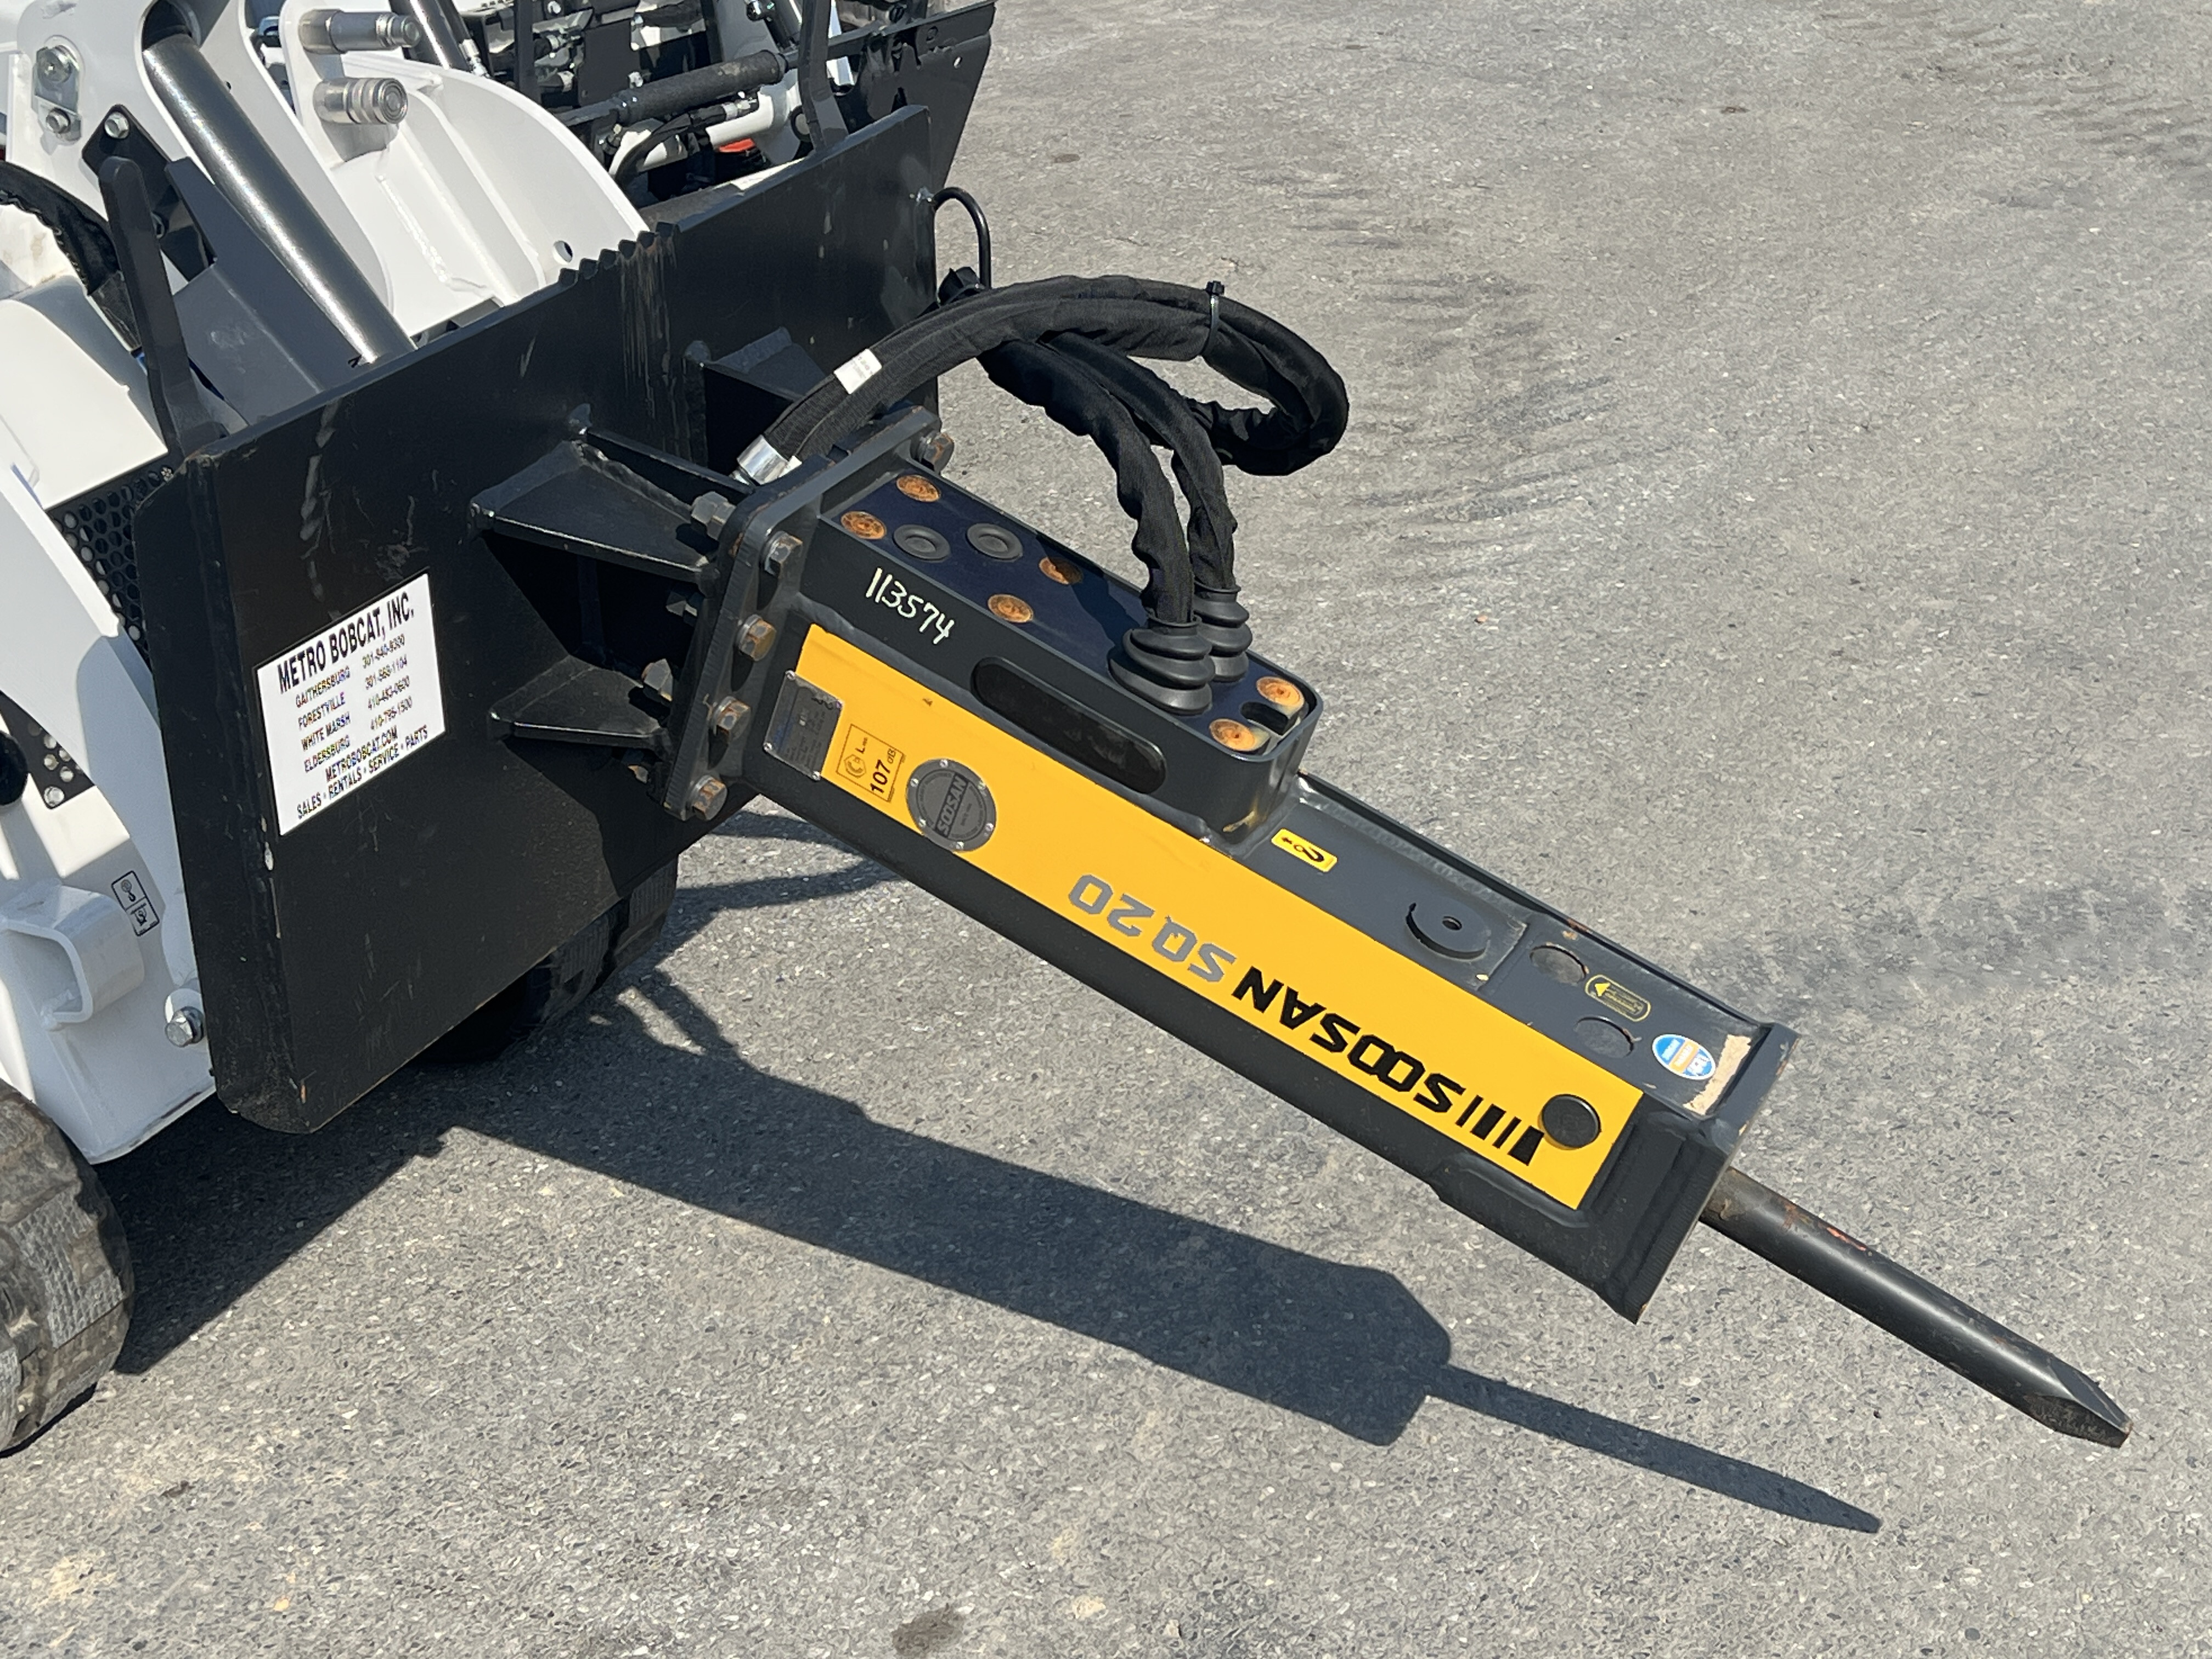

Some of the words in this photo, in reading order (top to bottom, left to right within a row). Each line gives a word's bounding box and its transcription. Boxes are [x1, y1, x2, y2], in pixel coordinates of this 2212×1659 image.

[866, 568, 955, 644] 113574
[277, 640, 326, 695] METRO
[329, 607, 385, 664] BOBCAT,
[387, 591, 414, 630] INC.
[296, 665, 351, 708] GAITHERSBURG
[298, 692, 345, 730] FORESTVILLE
[301, 727, 325, 752] WHITE
[325, 712, 351, 737] MARSH
[304, 735, 351, 772] ELDERSBURG
[297, 792, 321, 820] SALES
[328, 766, 362, 800] RENTALS
[369, 742, 399, 774] SERVICE
[405, 724, 428, 751] PARTS
[870, 759, 892, 794] 107
[936, 775, 969, 837] SOOSAN
[1231, 966, 1463, 1113] SOOSAN
